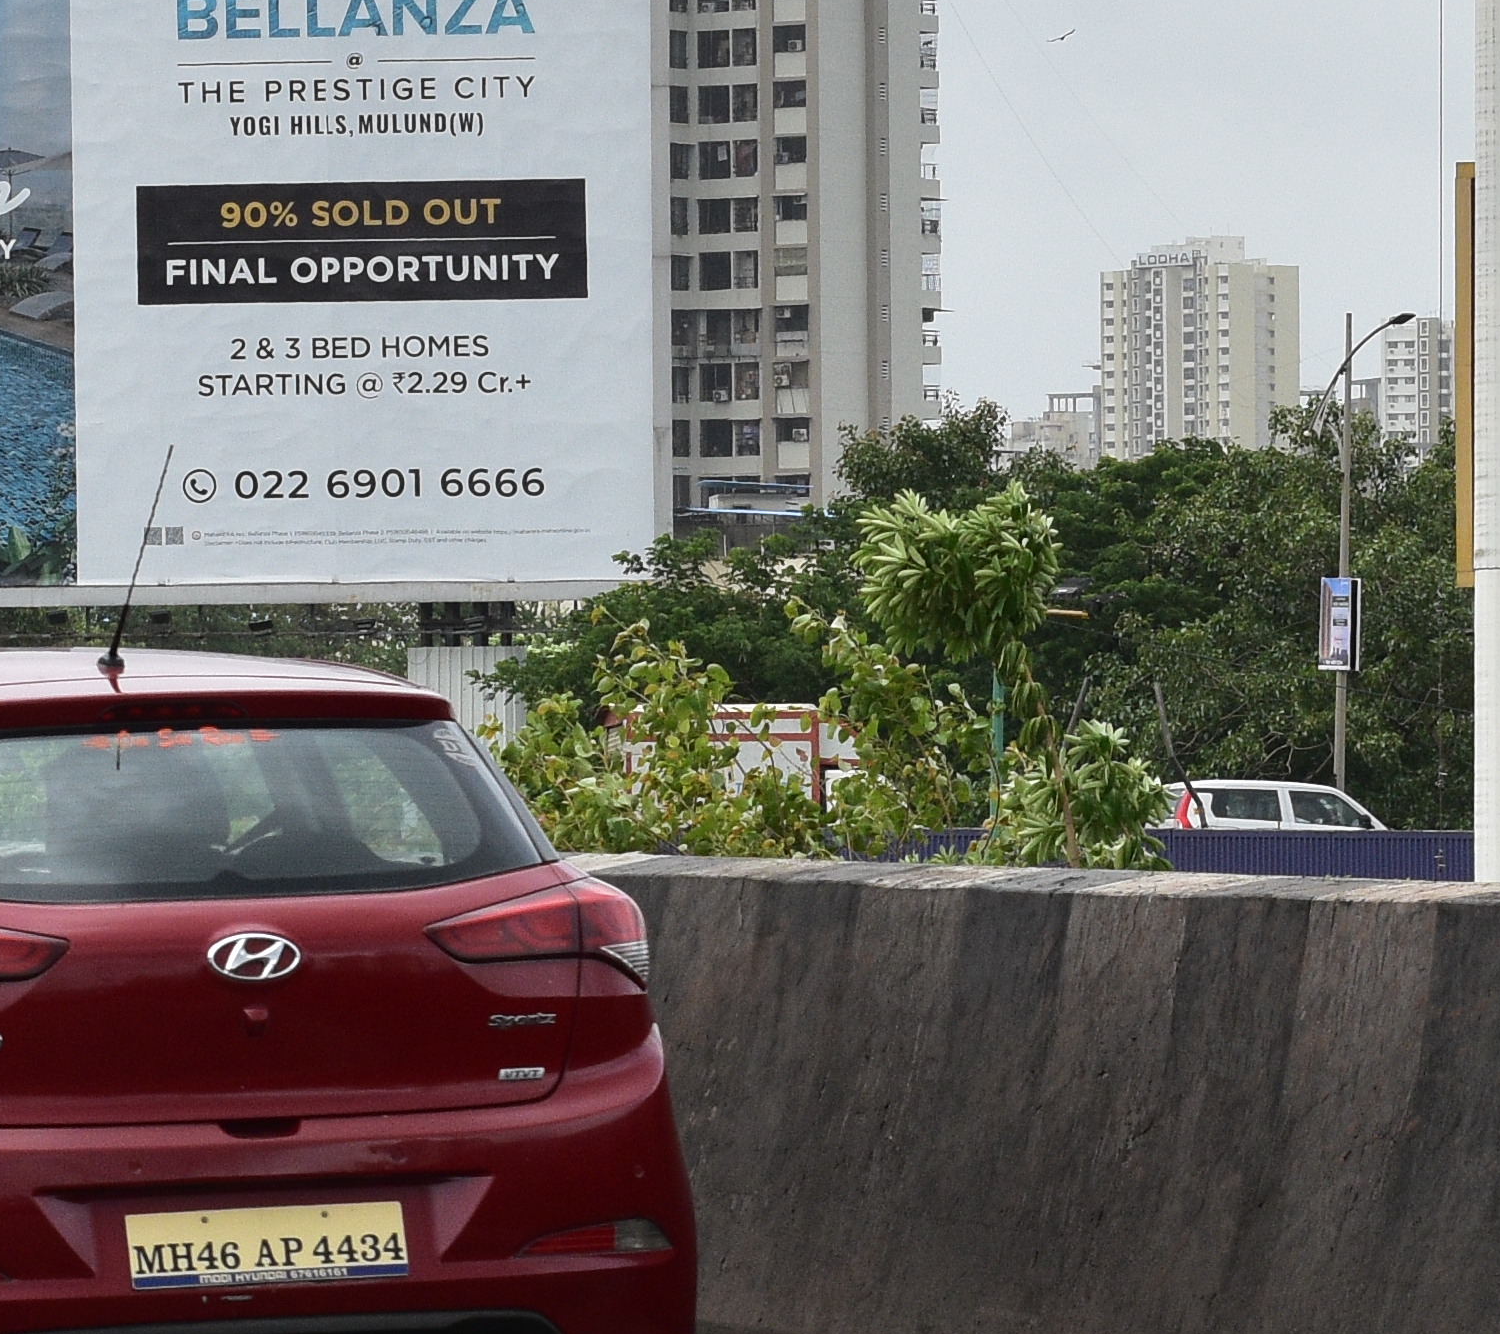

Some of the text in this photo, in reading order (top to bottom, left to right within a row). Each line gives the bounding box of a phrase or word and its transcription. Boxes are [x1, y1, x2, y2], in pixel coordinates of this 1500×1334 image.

[346, 52, 364, 69] @
[178, 75, 536, 105] THE PRESTIGE CITY
[230, 111, 485, 137] YOGI HILLS, MULUND(W)
[220, 197, 502, 229] 90% SOLD OUT
[166, 253, 560, 286] FINAL OPPORTUNITY
[230, 335, 490, 360] 2 & 3 BED HOMES
[198, 373, 347, 397] STARTING
[356, 372, 384, 400] @
[391, 371, 468, 395] ₹2.29
[234, 467, 546, 499] 022 6901 6666
[133, 1232, 405, 1275] MH46 AP 4434
